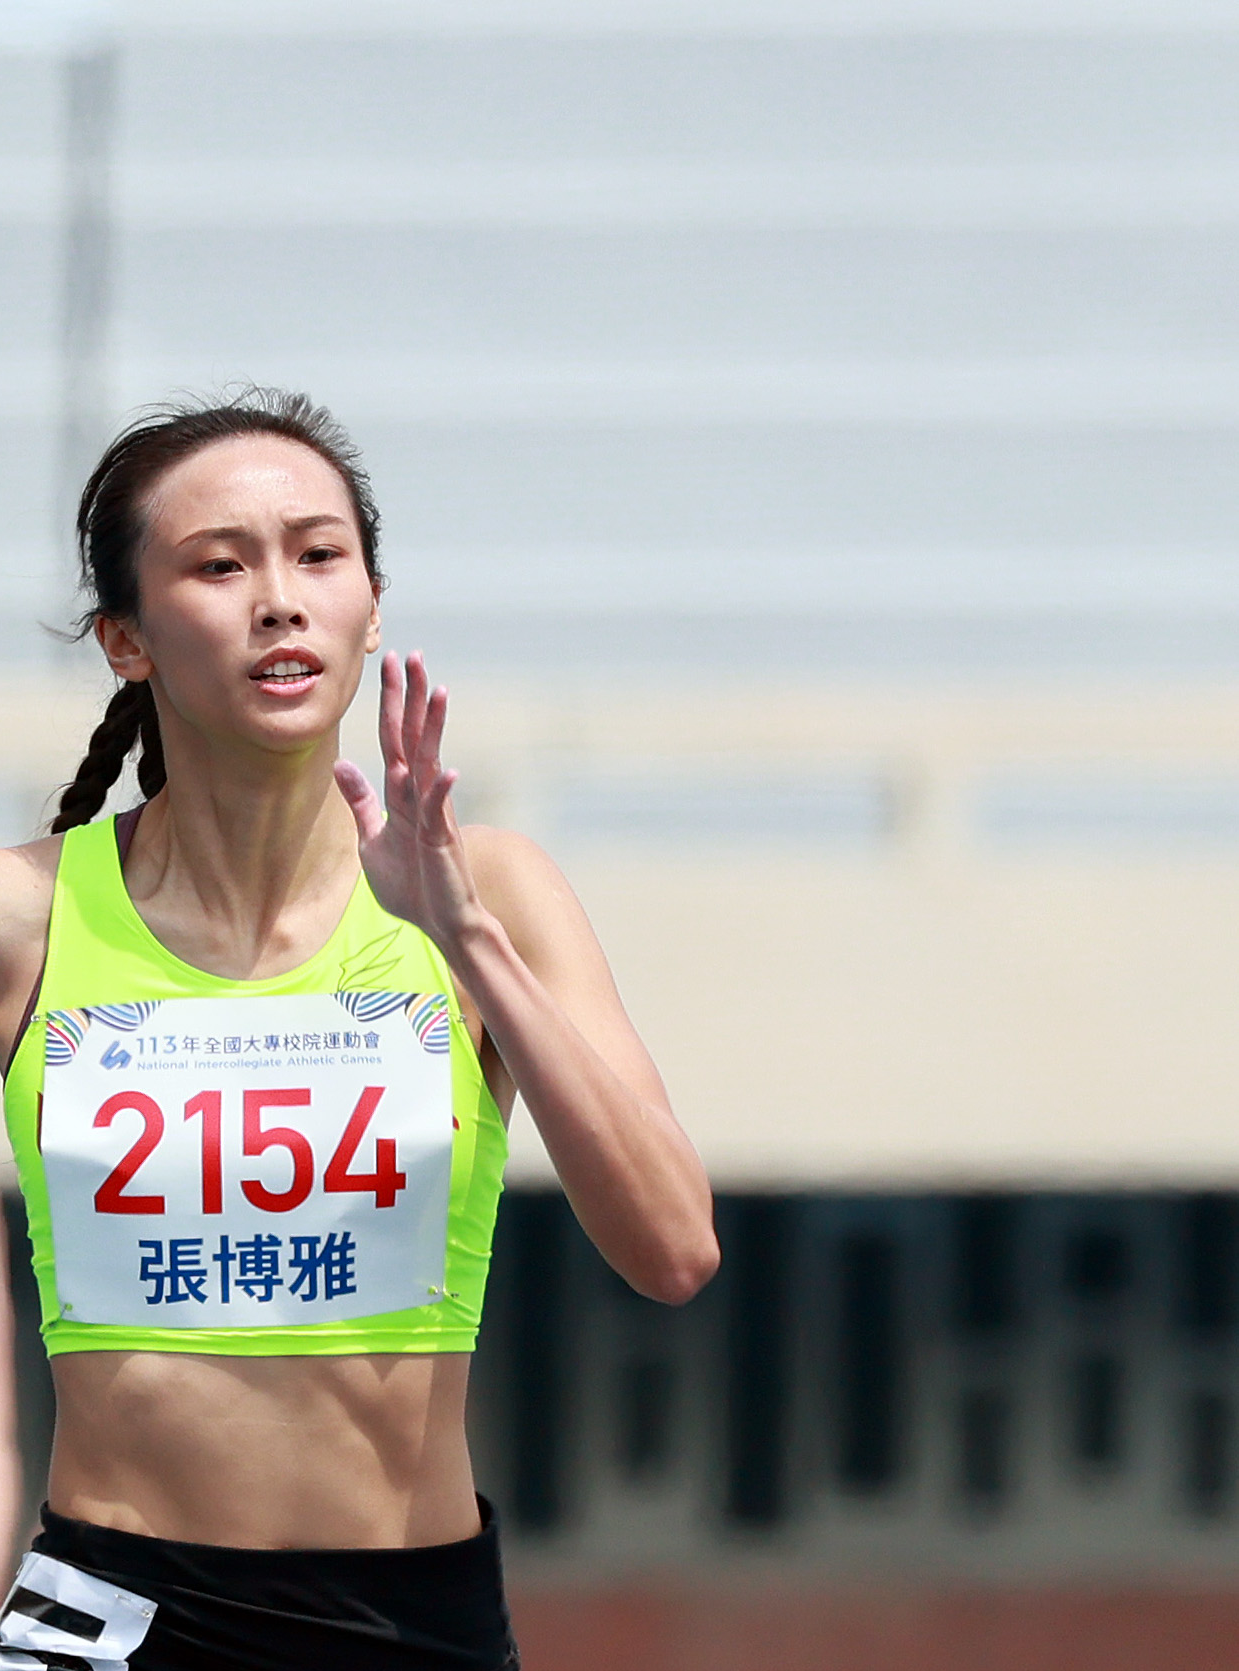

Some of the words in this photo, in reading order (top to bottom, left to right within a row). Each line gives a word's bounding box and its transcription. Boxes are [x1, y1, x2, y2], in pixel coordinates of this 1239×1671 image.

[137, 1059, 189, 1071] National
[194, 1056, 282, 1069] Intercollegiate
[287, 1054, 335, 1066] Athletic
[341, 1053, 382, 1065] Games
[92, 1086, 407, 1216] 2154
[138, 1231, 357, 1305] 張博雅
